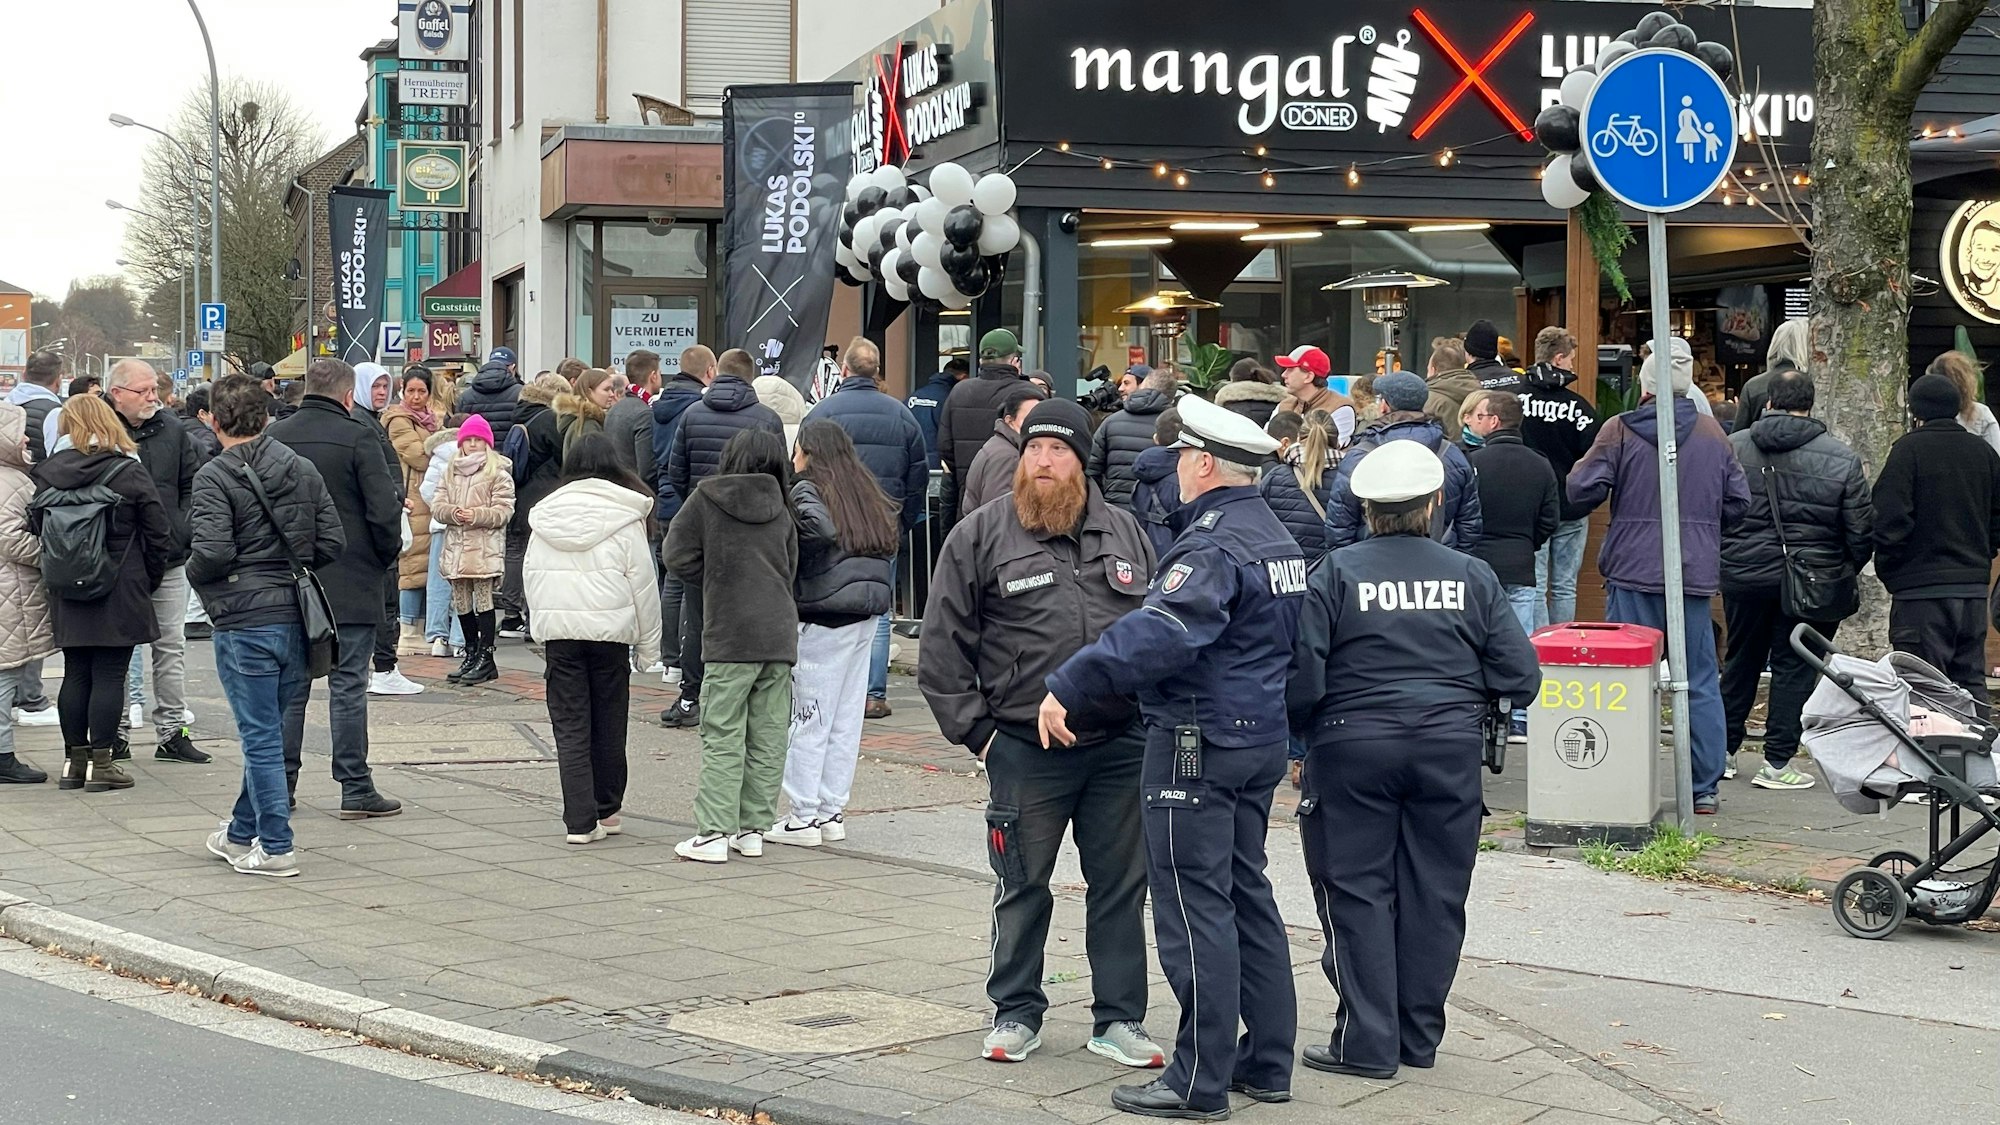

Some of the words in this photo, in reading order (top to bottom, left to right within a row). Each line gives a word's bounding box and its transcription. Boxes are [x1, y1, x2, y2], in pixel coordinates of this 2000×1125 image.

[418, 17, 450, 31] Gaffel
[902, 43, 939, 98] LUKAS
[404, 77, 464, 88] Hermülheimer
[410, 88, 458, 99] TREFF
[1288, 104, 1351, 126] DÖNER
[762, 174, 788, 253] LUKAS
[340, 250, 352, 310] LUKAS
[431, 302, 481, 312] Gaststätte
[641, 313, 660, 323] ZU
[615, 326, 695, 337] VERMIETEN
[648, 339, 661, 347] 80
[1028, 424, 1075, 437] ORDNUNGSAMT
[1006, 572, 1055, 593] ORDNUNGSAMT
[1358, 580, 1465, 612] POLIZEI
[1541, 679, 1627, 711] B312
[1159, 790, 1187, 800] POLIZEI
